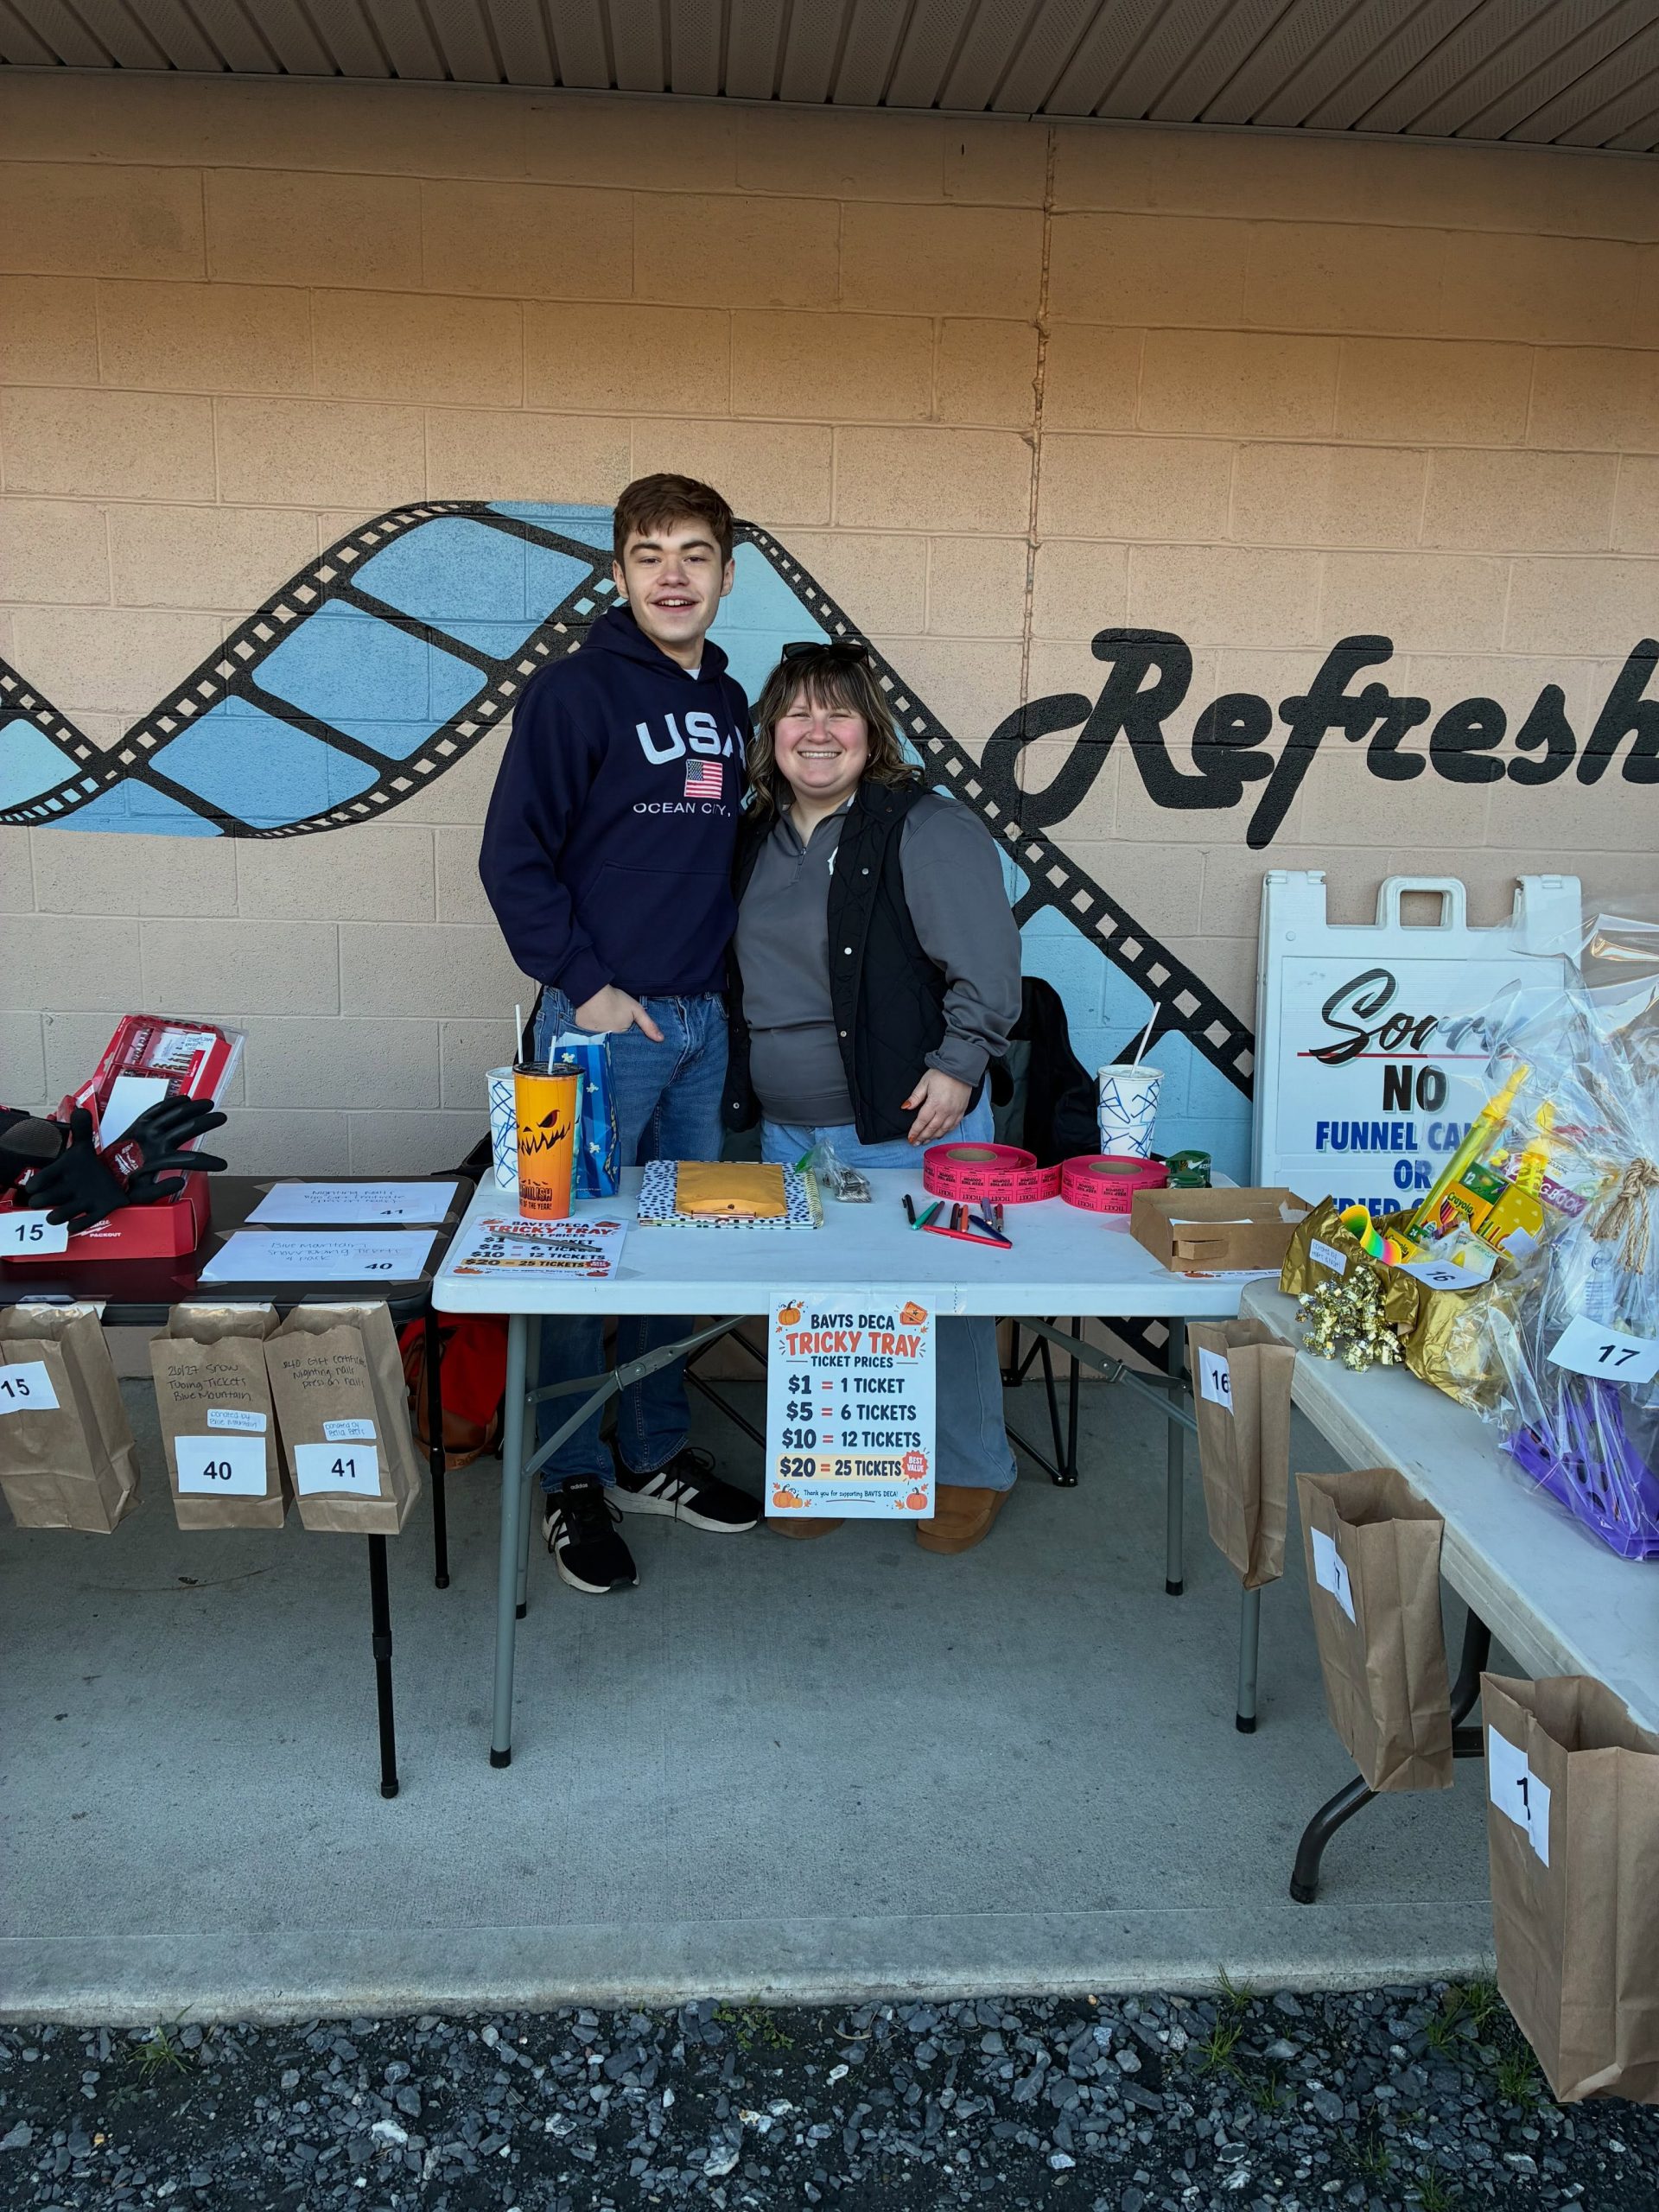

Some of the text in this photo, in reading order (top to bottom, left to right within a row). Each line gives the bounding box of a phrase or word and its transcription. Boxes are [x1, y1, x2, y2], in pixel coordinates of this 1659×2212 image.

[633, 802, 696, 814] OCEAN
[1382, 1065, 1448, 1112] NO
[1316, 1121, 1419, 1151] FUNNEL
[1394, 1159, 1433, 1190] OR
[1464, 1171, 1476, 1185] 12
[1446, 1192, 1474, 1214] Crayola
[15, 1224, 44, 1242] 15
[487, 1225, 556, 1234] TRICKY
[1426, 1270, 1456, 1282] 16
[810, 1314, 895, 1331] BAVTS DECA
[785, 1331, 921, 1358] TRICKY TRAY
[810, 1356, 893, 1369] TICKET PRICES
[1598, 1344, 1640, 1367] 17
[1, 1378, 30, 1398] 15
[788, 1374, 812, 1395] $1
[841, 1377, 849, 1394] 1
[854, 1377, 905, 1394] TICKET
[1211, 1370, 1230, 1394] 16
[174, 1391, 196, 1402] Blue
[786, 1401, 814, 1421] $5
[841, 1404, 852, 1421] 6
[856, 1404, 917, 1421] TICKETS
[781, 1427, 817, 1449] $10
[841, 1432, 858, 1447] 12
[861, 1432, 921, 1448] TICKETS
[203, 1460, 232, 1480] 40
[331, 1458, 356, 1478] 41
[779, 1456, 817, 1478] $20
[835, 1459, 852, 1476] 25
[855, 1460, 902, 1477] TICKETS
[907, 1463, 925, 1473] VALUE
[908, 1455, 924, 1465] BEST
[839, 1491, 863, 1499] supporting
[1516, 1777, 1531, 1821] 1
